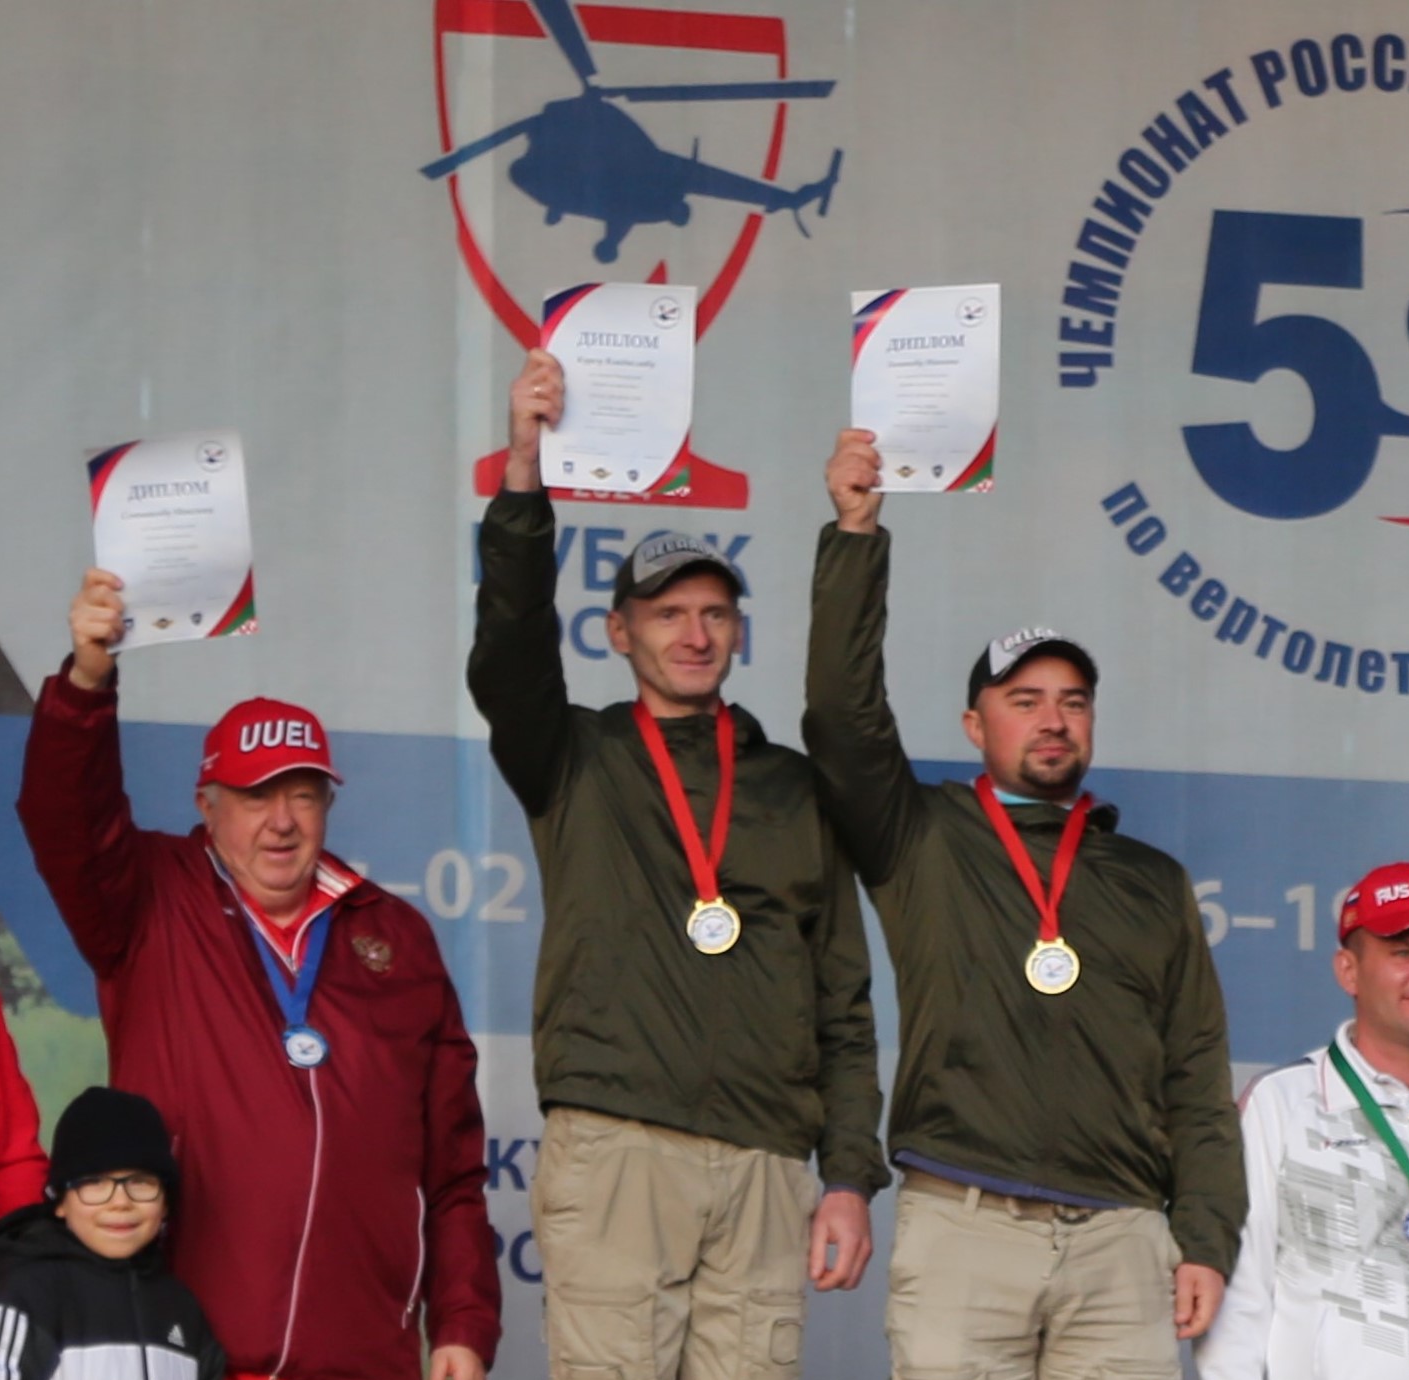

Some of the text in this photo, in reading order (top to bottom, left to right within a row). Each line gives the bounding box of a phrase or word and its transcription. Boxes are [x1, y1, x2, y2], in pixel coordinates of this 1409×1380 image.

[1058, 68, 1251, 388] ЧЕМПИОНАТ
[575, 331, 659, 349] ДИПЛОМ
[886, 334, 966, 353] ДИПЛОМ
[127, 480, 210, 503] ДИПЛОМ
[240, 719, 321, 753] UUEL
